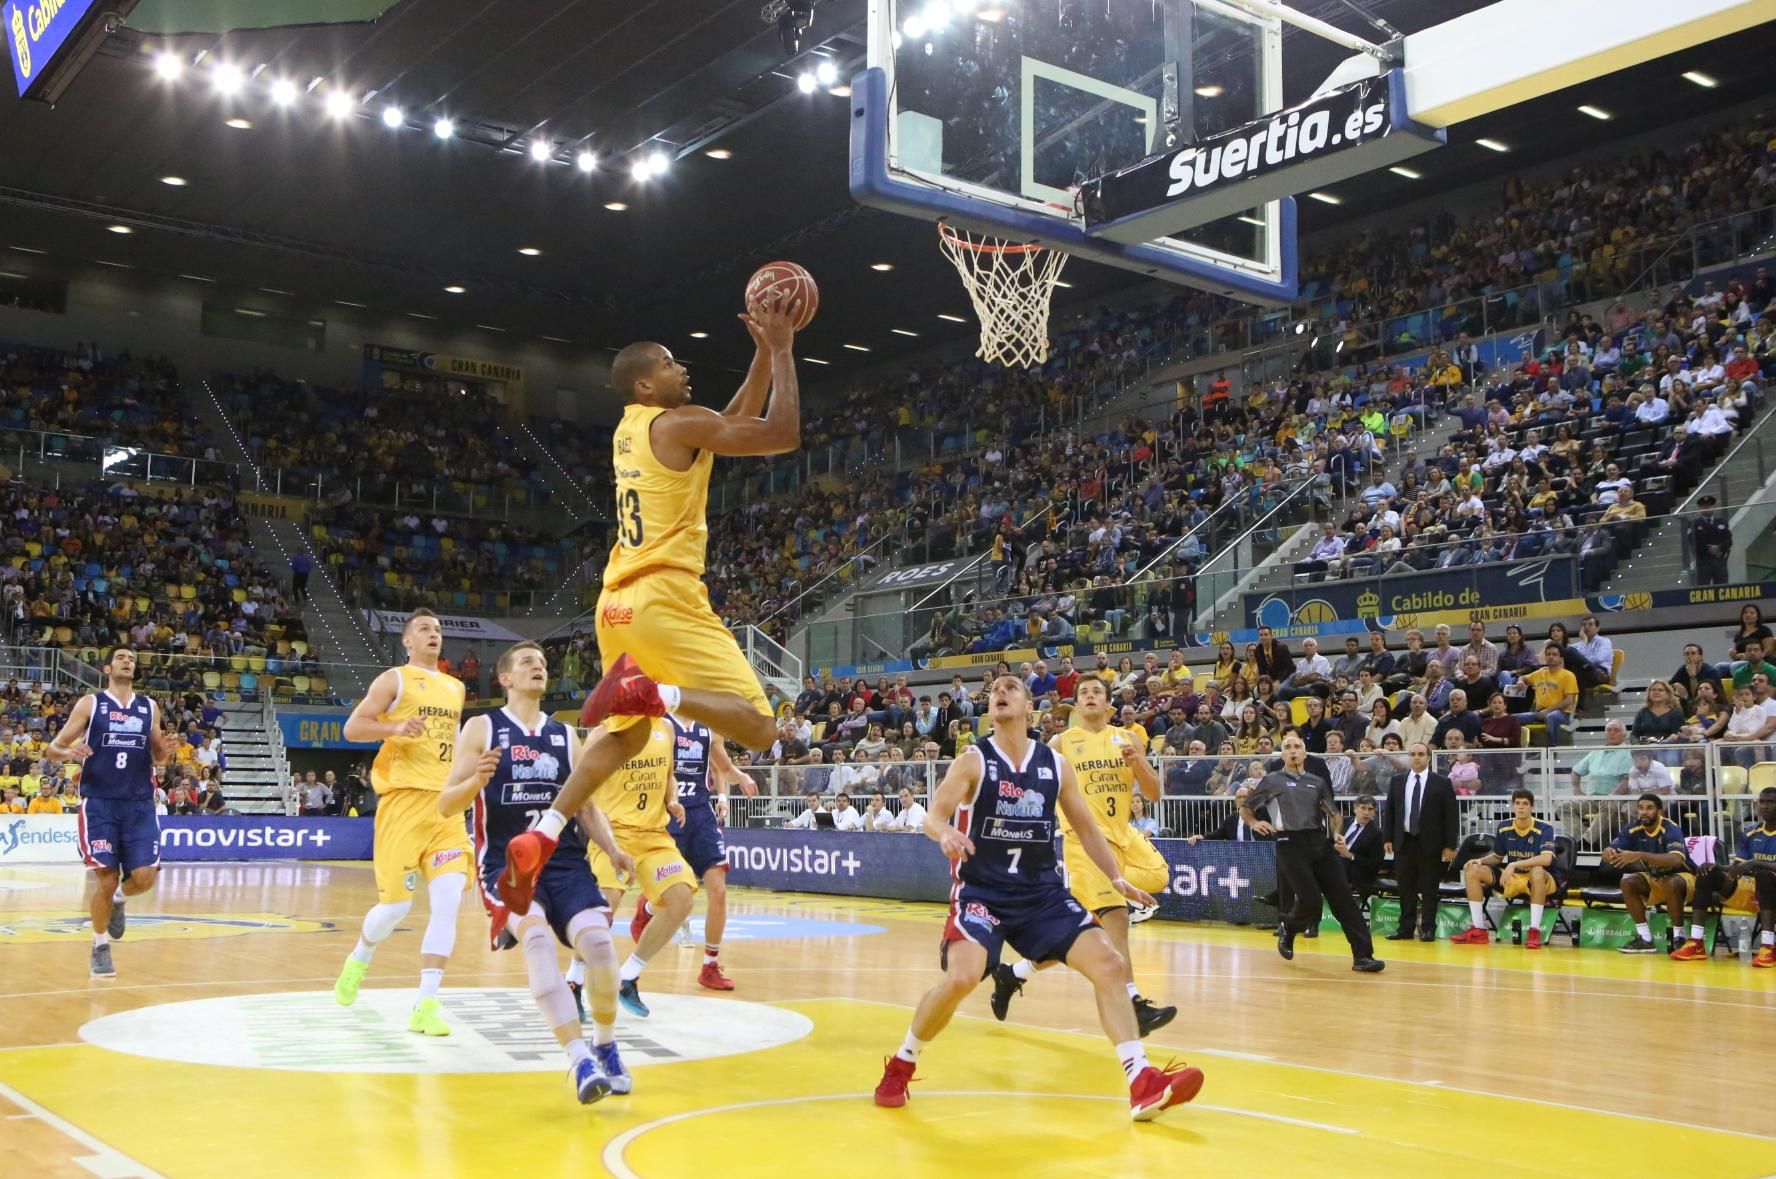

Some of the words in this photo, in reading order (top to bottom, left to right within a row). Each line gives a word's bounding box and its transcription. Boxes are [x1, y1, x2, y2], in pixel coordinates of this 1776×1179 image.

[1166, 103, 1385, 197] suertia.es
[481, 362, 521, 381] CANARIA
[239, 502, 286, 519] ANARIA
[876, 562, 955, 585] ROES
[1392, 590, 1454, 612] Cabildo
[1460, 587, 1480, 604] de
[1690, 589, 1714, 603] GRAN
[1719, 586, 1761, 601] CANARIA
[1469, 608, 1490, 621] GRAN
[1493, 606, 1527, 620] CANARIA
[1291, 624, 1318, 637] CANARIA
[1094, 644, 1107, 654] GRAN
[1109, 642, 1132, 652] CANARIA
[300, 720, 341, 742] GRAN
[115, 752, 128, 769] 8
[511, 745, 540, 761] Rio
[1089, 769, 1121, 783] Gran
[677, 781, 697, 797] 22
[999, 780, 1024, 799] Rio
[1084, 781, 1129, 796] Canaria
[637, 792, 648, 811] 8
[1106, 796, 1116, 817] 3
[161, 825, 331, 848] movistar+
[726, 845, 861, 877] movistar+
[1007, 847, 1022, 874] 7
